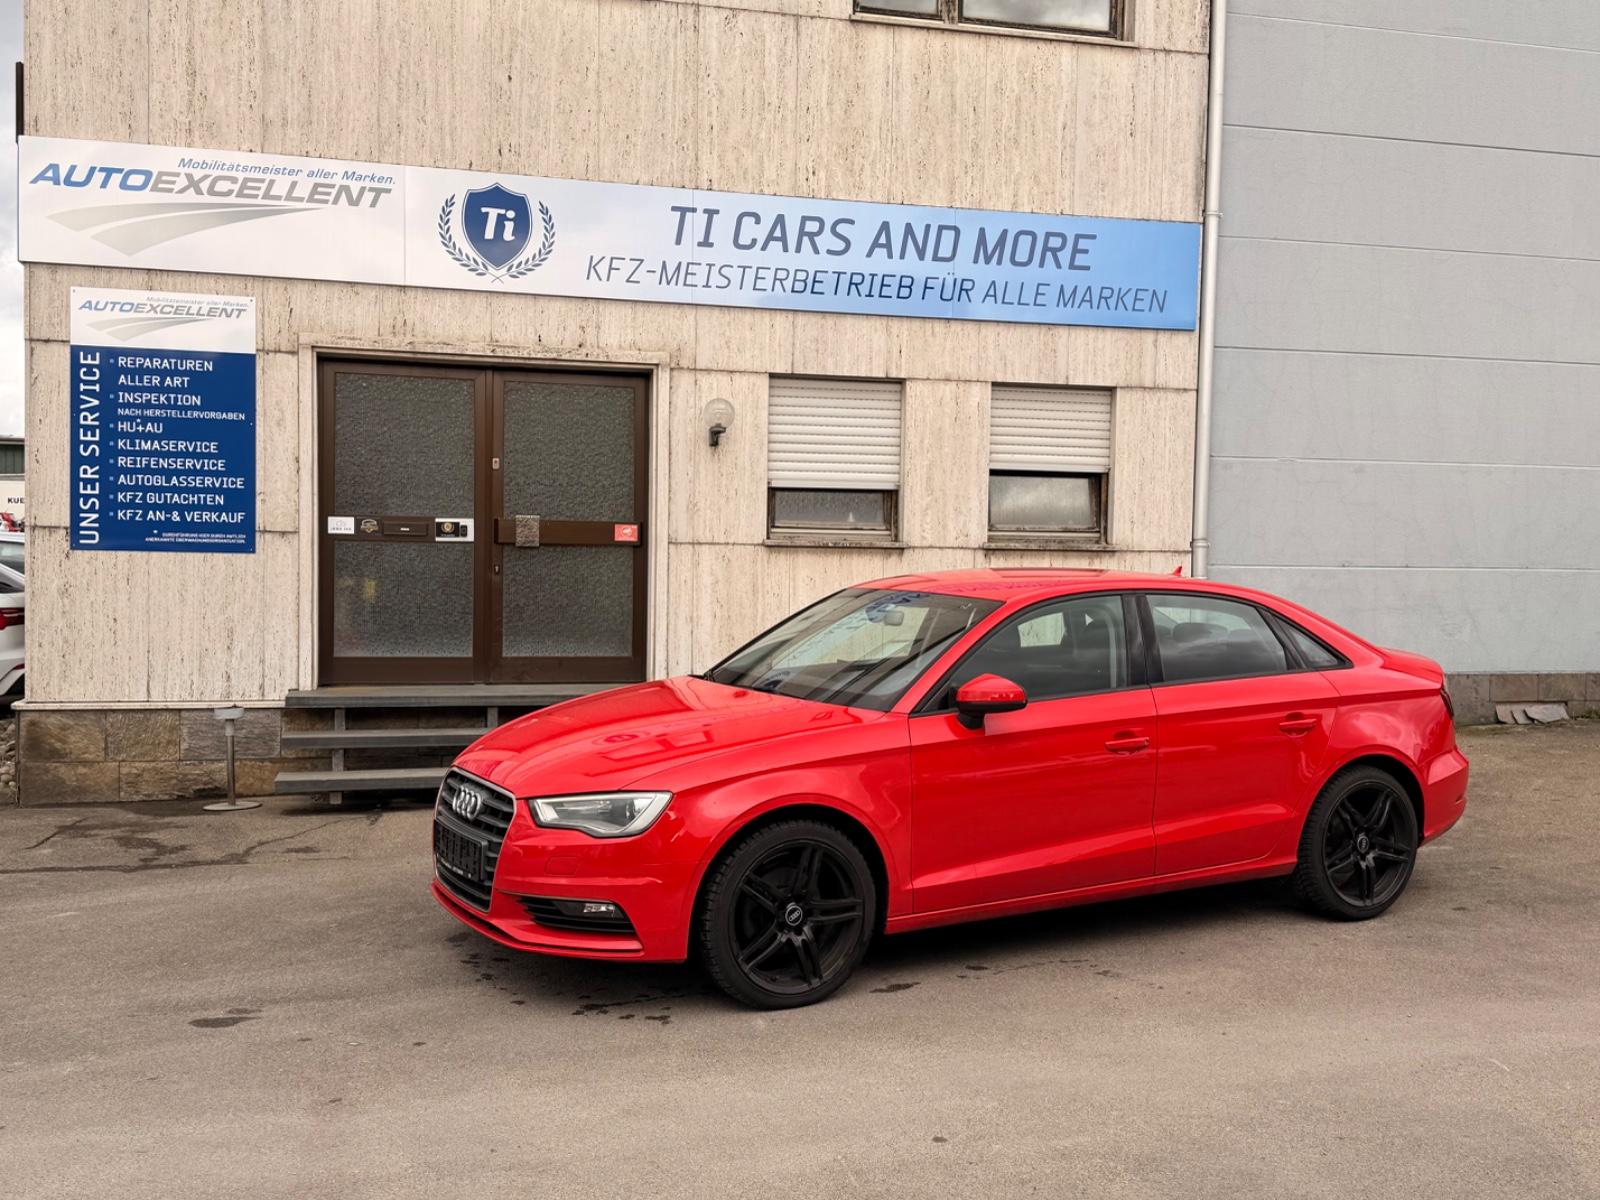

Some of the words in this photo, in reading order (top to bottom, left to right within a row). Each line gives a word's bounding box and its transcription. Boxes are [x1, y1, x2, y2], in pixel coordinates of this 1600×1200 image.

[177, 157, 302, 177] Mobilitätsmeister
[306, 167, 338, 181] aller
[342, 170, 396, 185] Marken.
[29, 162, 392, 209] AUTOEXCELLENT
[480, 206, 516, 242] Ti
[670, 205, 720, 248] TI
[732, 211, 856, 257] CARS
[865, 220, 961, 263] AND
[972, 227, 1097, 271] MORE
[586, 255, 914, 301] KFZ-MEISTERBETRIEB
[921, 272, 976, 303] FÜR
[981, 279, 1051, 307] ALLE
[1056, 284, 1169, 313] MARKEN
[78, 300, 248, 319] AUTOEXCELLENT
[118, 356, 213, 372] REPARATUREN
[118, 374, 160, 387] ALLER
[164, 376, 190, 389] ART
[79, 351, 100, 457] SERVICE
[118, 391, 201, 406] INSPEKTION
[118, 408, 142, 417] NACH
[143, 408, 246, 421] HERSTELLERVORGABEN
[118, 438, 219, 453] KLIMASERVICE
[118, 456, 226, 471] REIFENSERVICE
[118, 474, 245, 489] AUTOGLASSERVICE
[79, 465, 100, 545] UNSER
[118, 492, 143, 503] KFZ
[146, 493, 224, 506] GUTACHTEN
[118, 509, 143, 521] KFZ
[185, 511, 246, 523] VERKAUF
